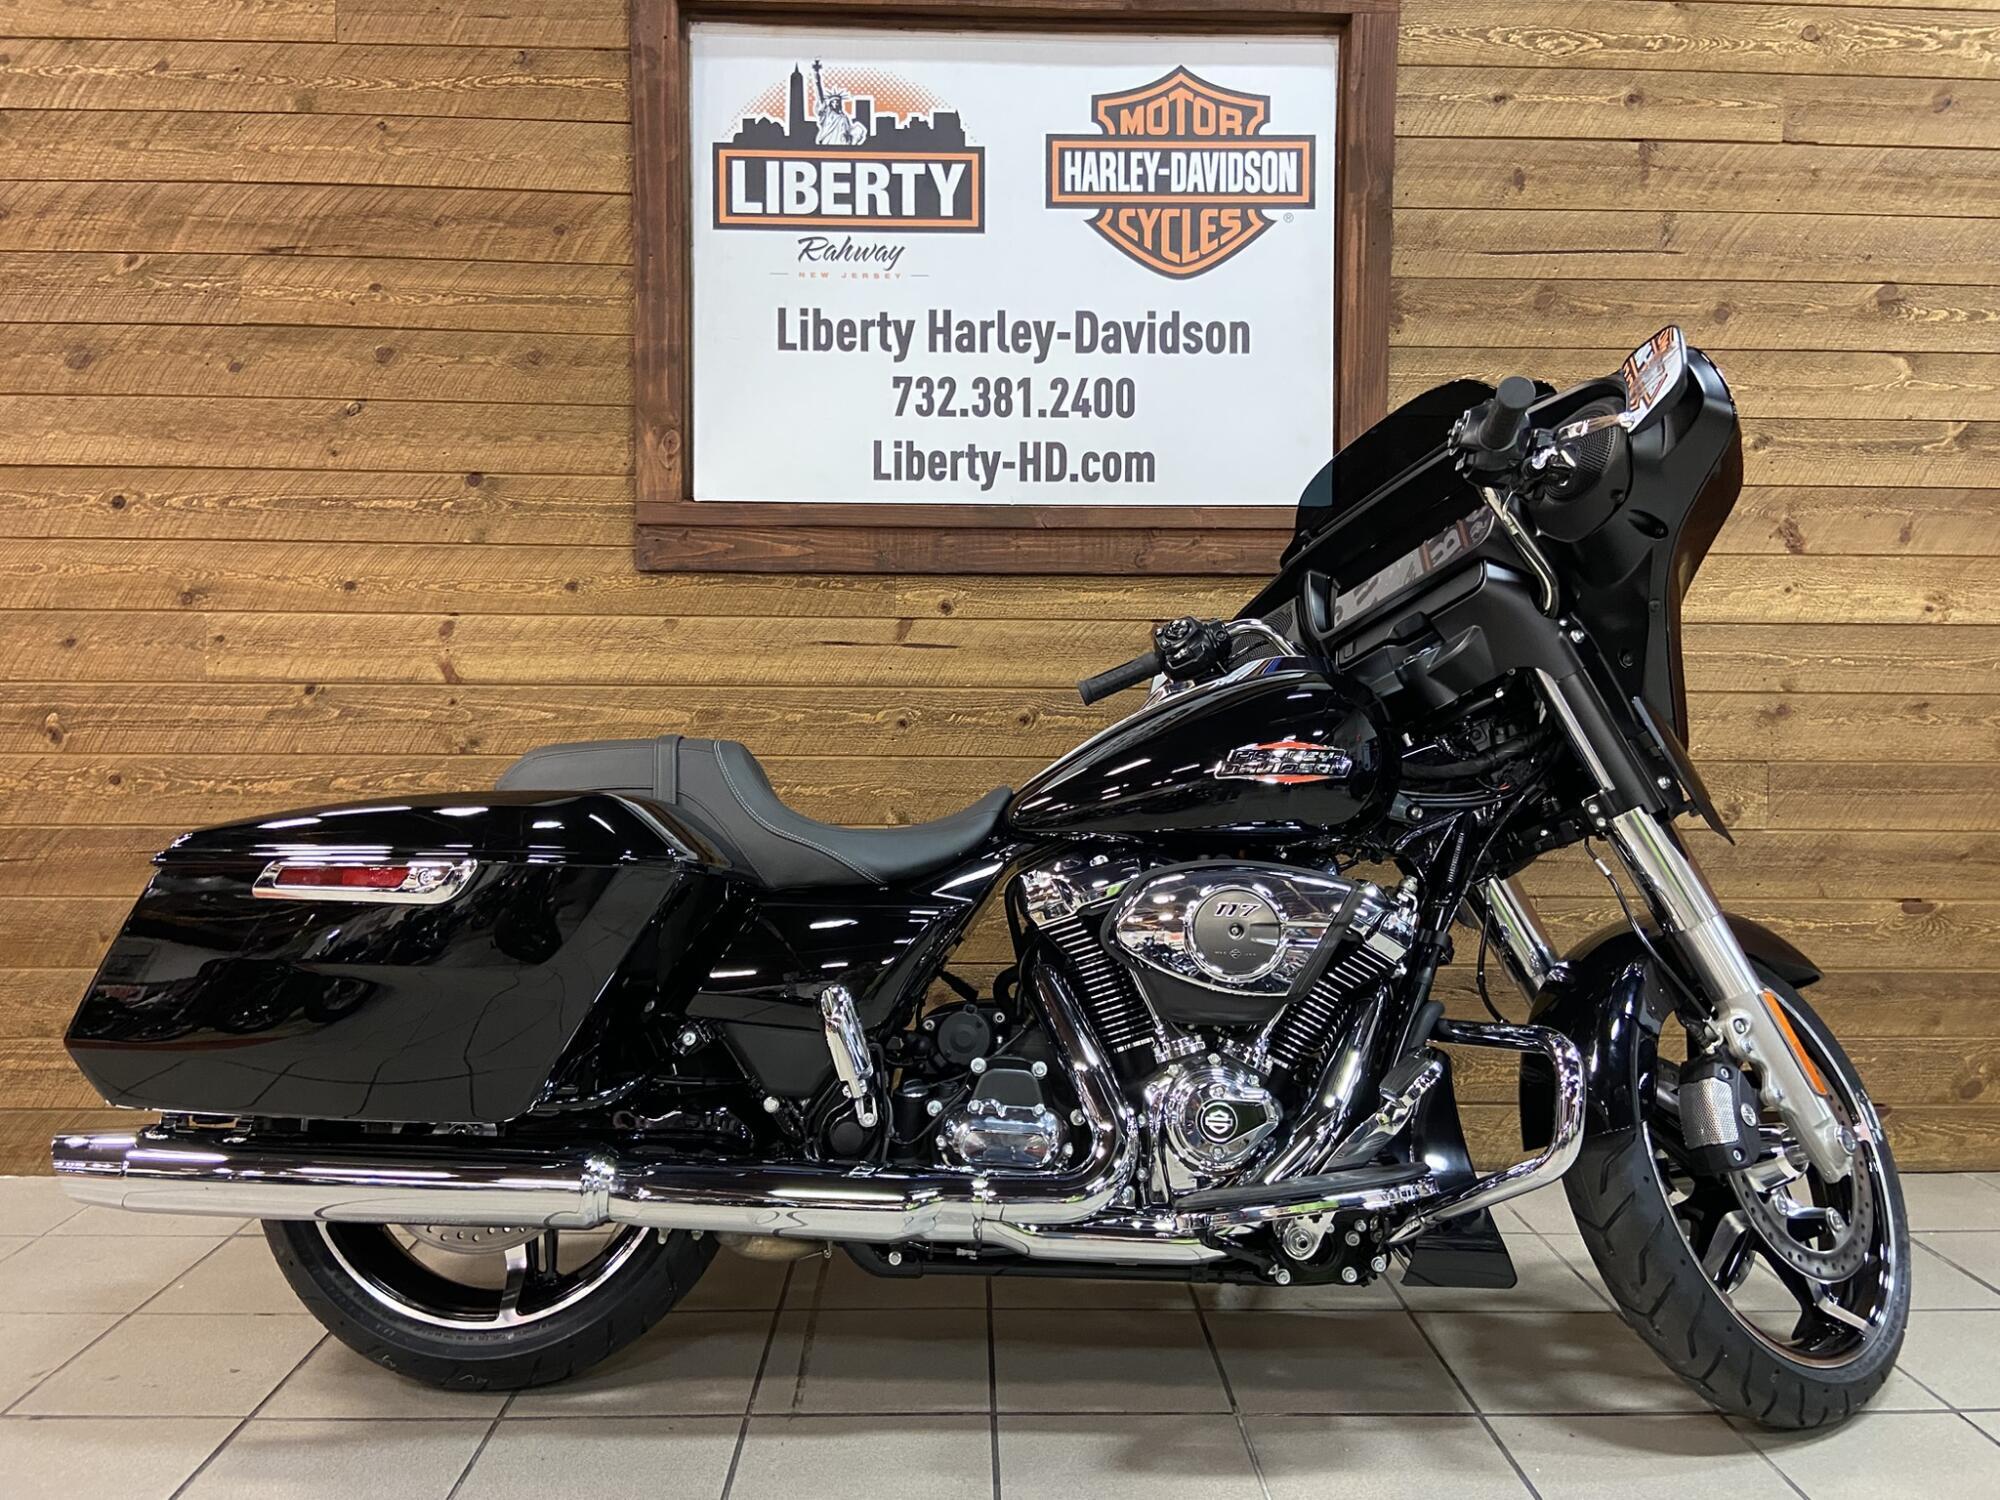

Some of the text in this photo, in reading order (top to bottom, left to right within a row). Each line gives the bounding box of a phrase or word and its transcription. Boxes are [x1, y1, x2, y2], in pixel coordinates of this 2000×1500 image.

[1119, 86, 1243, 136] MOTOR
[731, 159, 967, 217] LIBERTY
[1063, 150, 1298, 194] HARLEY-DAVIDSON
[797, 235, 907, 271] Rahway
[1118, 208, 1243, 264] CYCLES
[799, 271, 902, 280] NEW JERSEY
[777, 307, 1251, 365] Liberty Harley-Davidson
[891, 376, 1136, 419] 732.381.2400
[872, 439, 1157, 492] Liberty-HD.com
[1214, 902, 1262, 918] 117
